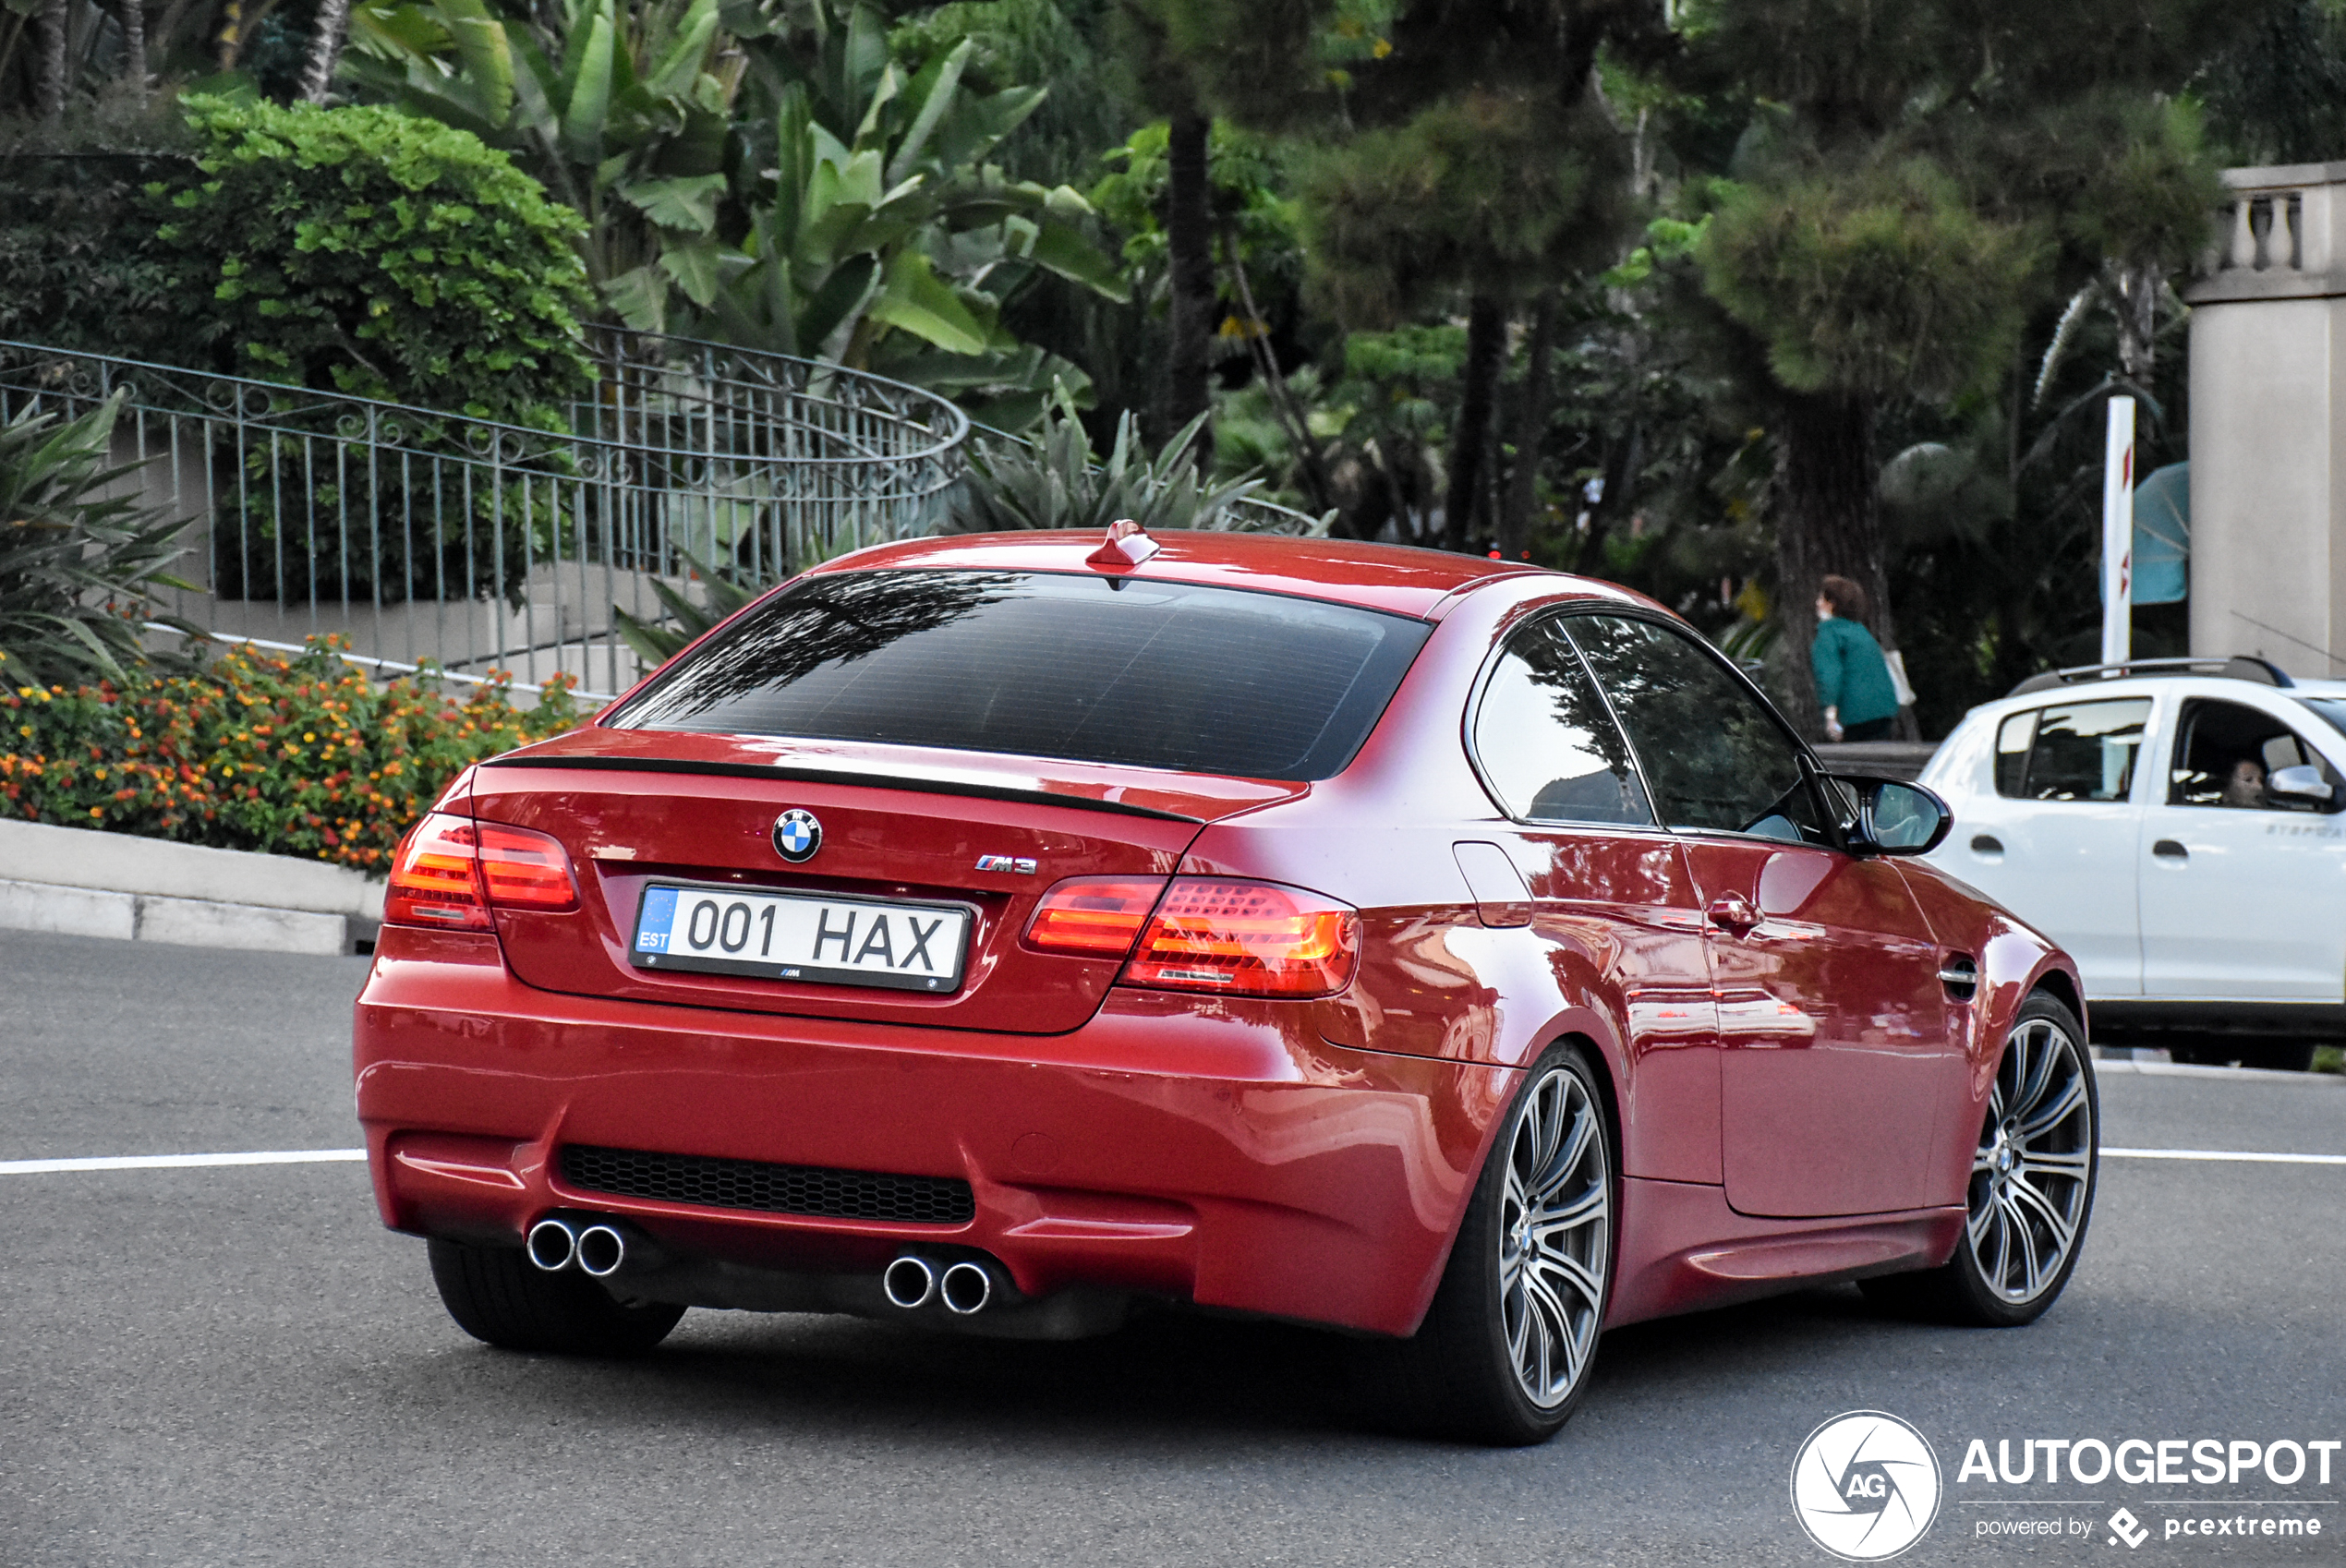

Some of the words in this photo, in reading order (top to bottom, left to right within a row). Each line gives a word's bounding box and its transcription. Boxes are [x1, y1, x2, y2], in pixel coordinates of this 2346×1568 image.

[778, 812, 817, 830] BMW
[976, 855, 1037, 874] M3
[639, 932, 669, 947] EST
[688, 899, 776, 956] 001
[812, 908, 943, 971] HAX
